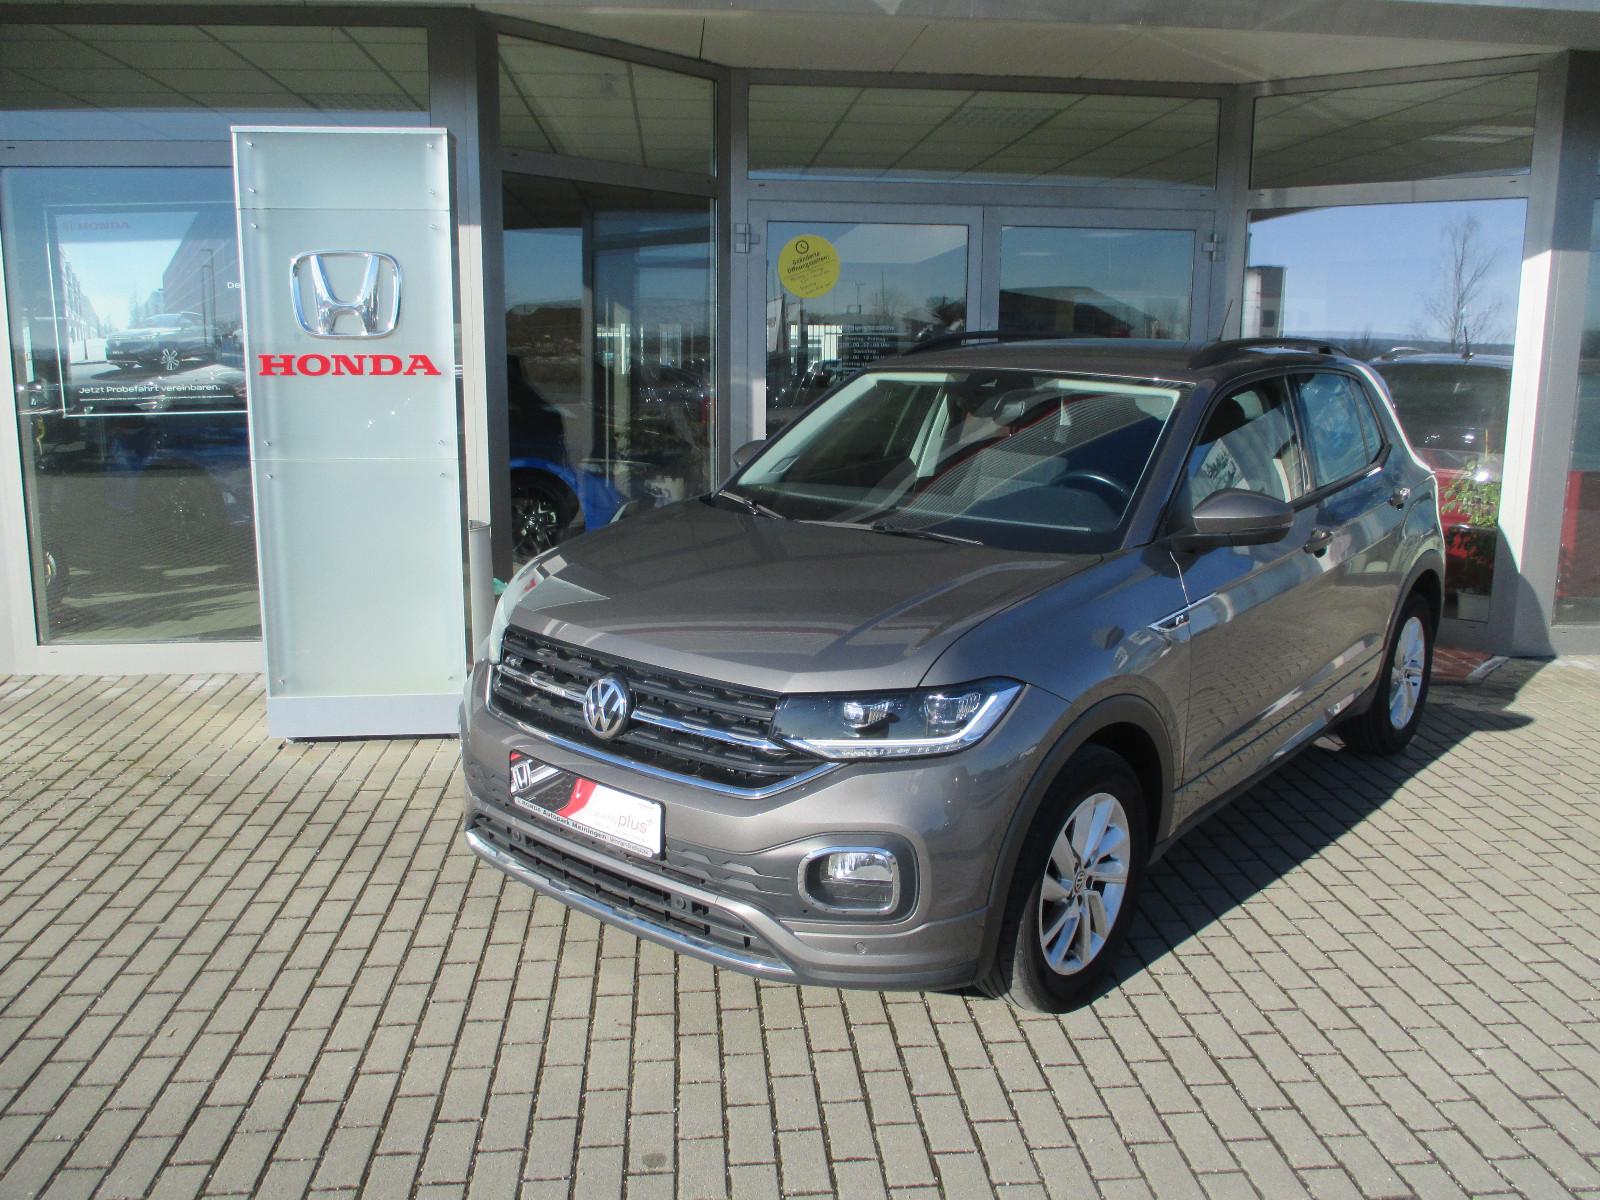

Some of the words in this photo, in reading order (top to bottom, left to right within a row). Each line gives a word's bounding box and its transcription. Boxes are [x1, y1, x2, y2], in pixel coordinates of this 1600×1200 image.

[257, 353, 442, 377] HONDA
[79, 386, 105, 394] Jetzt
[106, 384, 159, 393] Probefahrt
[161, 384, 221, 392] vereinbaren.
[542, 809, 570, 826] Autopark
[571, 821, 607, 840] Meiningen
